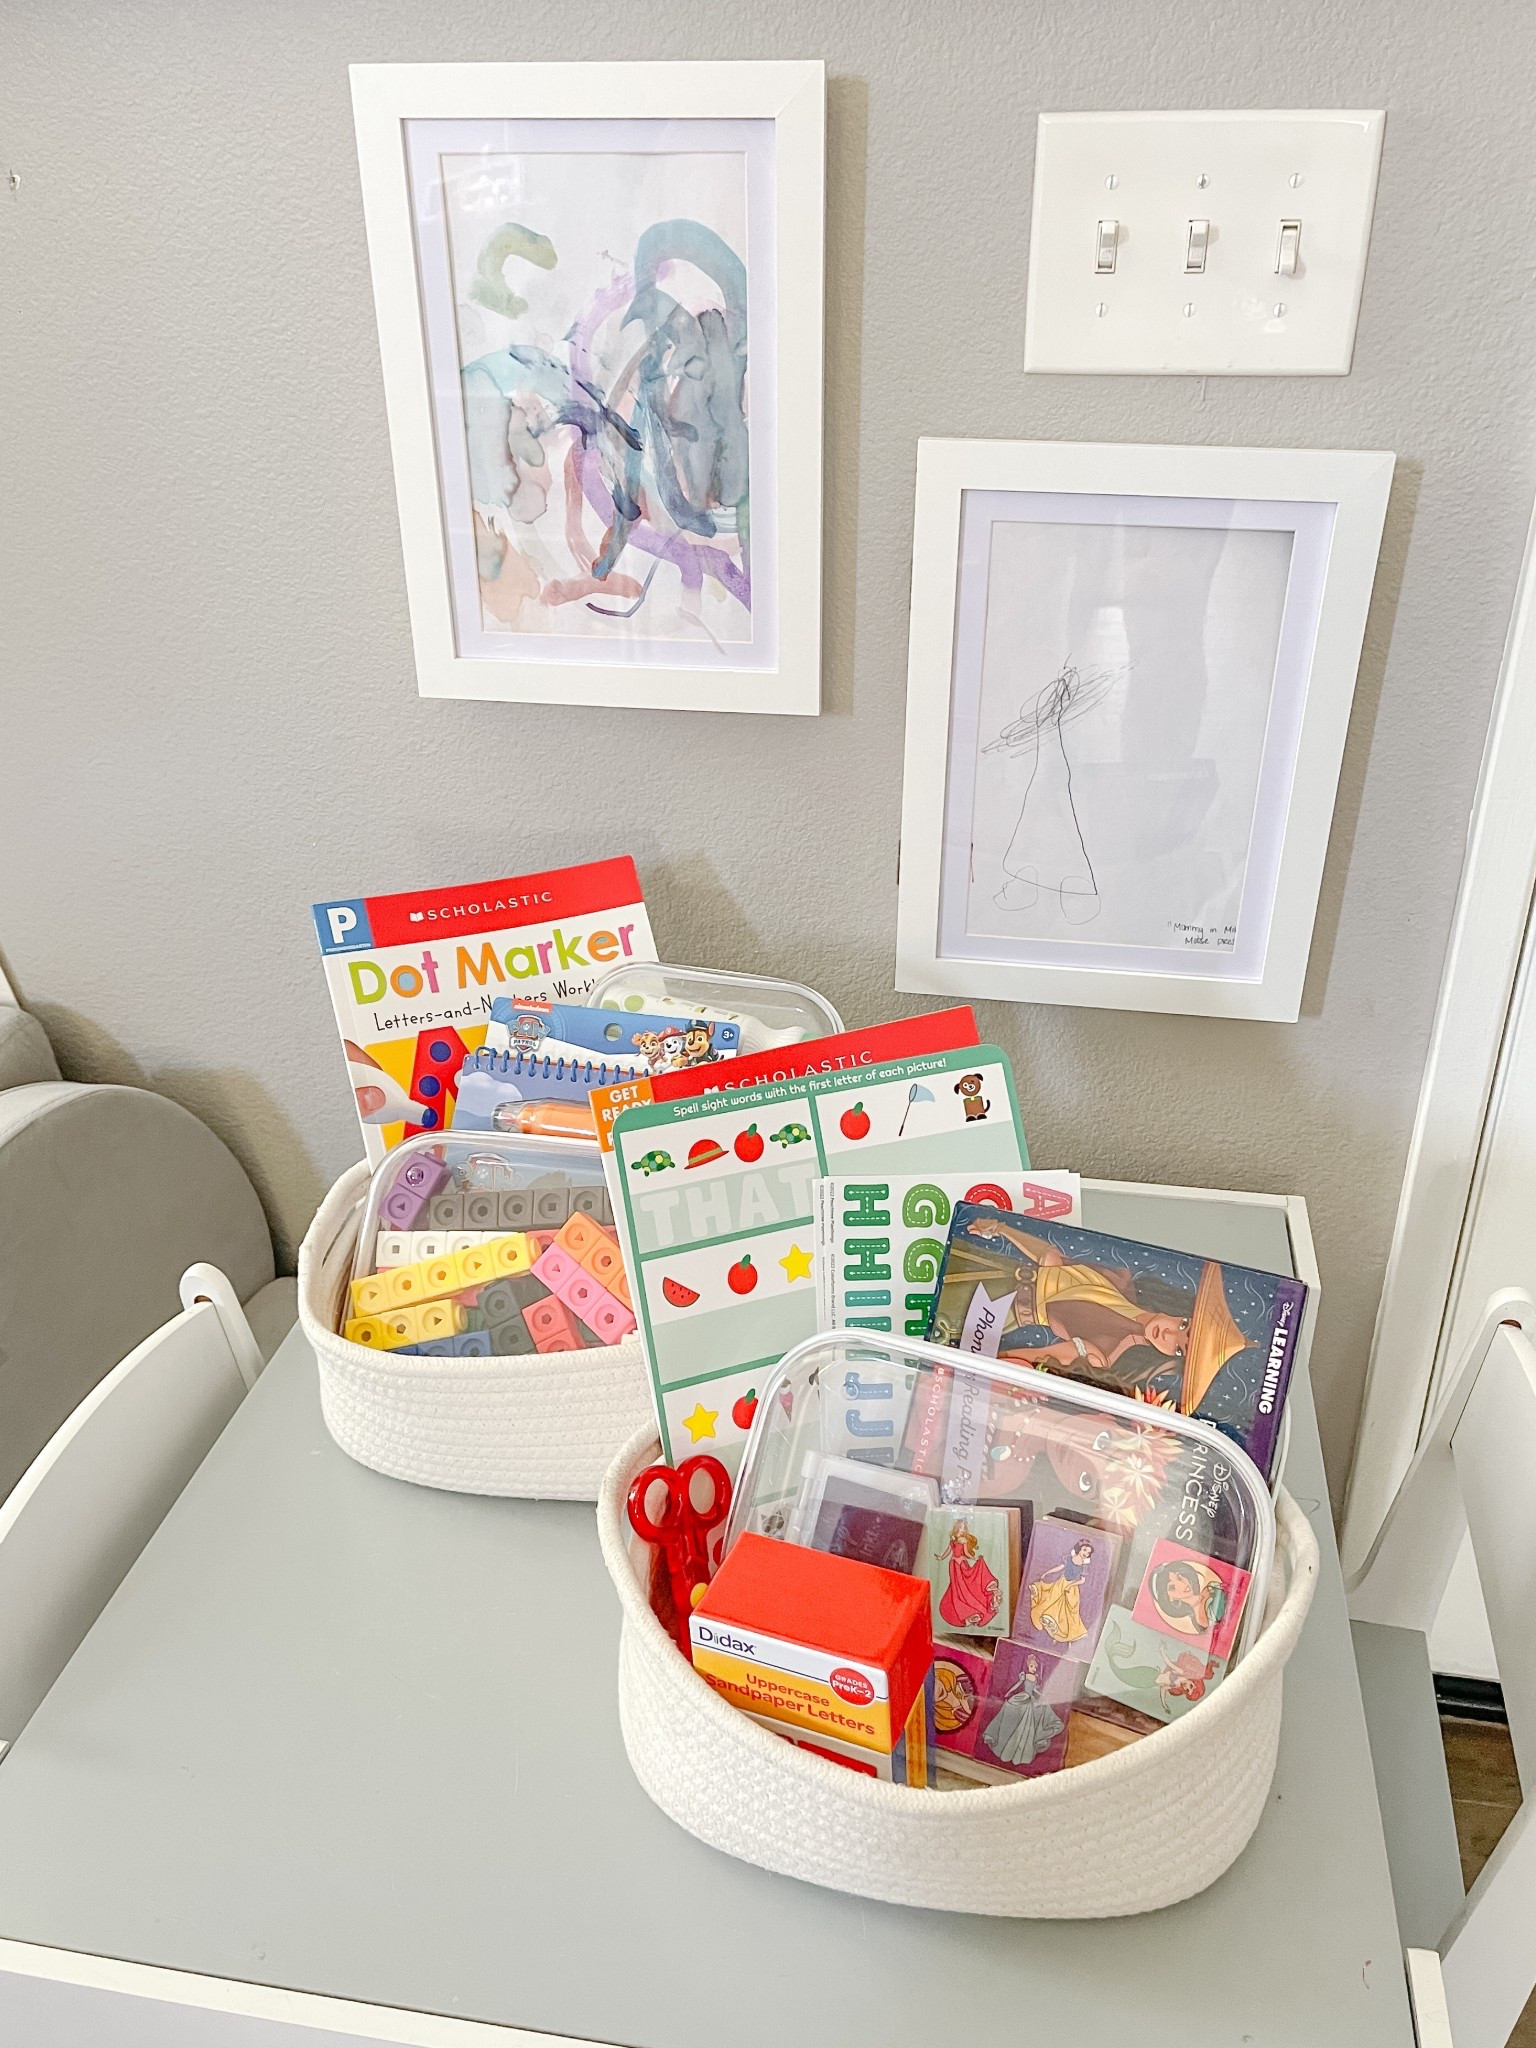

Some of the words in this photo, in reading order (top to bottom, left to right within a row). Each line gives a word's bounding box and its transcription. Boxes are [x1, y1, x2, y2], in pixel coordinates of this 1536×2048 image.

[327, 907, 357, 944] P
[428, 891, 552, 922] SCHOLASTIC
[347, 951, 440, 1005] Dot
[455, 923, 635, 989] Marker
[374, 991, 547, 1032] Letters-and-Ners
[552, 979, 595, 999] Work
[513, 1038, 538, 1048] PATROL
[722, 1030, 735, 1040] 3+
[673, 1102, 699, 1118] Spell
[701, 1098, 728, 1113] sight
[731, 1092, 762, 1105] words
[765, 1087, 787, 1099] with
[789, 1083, 807, 1095] the
[809, 1079, 832, 1092] first
[834, 1073, 863, 1087] letter
[865, 1069, 877, 1081] of
[879, 1064, 905, 1078] each
[907, 1057, 947, 1076] picture!
[724, 1051, 873, 1091] SCHOLASTIC
[609, 1085, 638, 1103] GET
[640, 1163, 816, 1247] THAT
[843, 1183, 891, 1227] H
[902, 1183, 950, 1228] G
[843, 1237, 891, 1281] H
[1276, 1301, 1294, 1328] Disney
[1258, 1327, 1288, 1415] LEARNING
[914, 1375, 944, 1474] SCHOLASTIC
[951, 1384, 980, 1461] Reading
[699, 1626, 755, 1656] Didax
[746, 1672, 830, 1707] Uppercase
[834, 1673, 868, 1689] GRADES
[703, 1673, 804, 1712] Sandpaper
[807, 1703, 875, 1736] Letters
